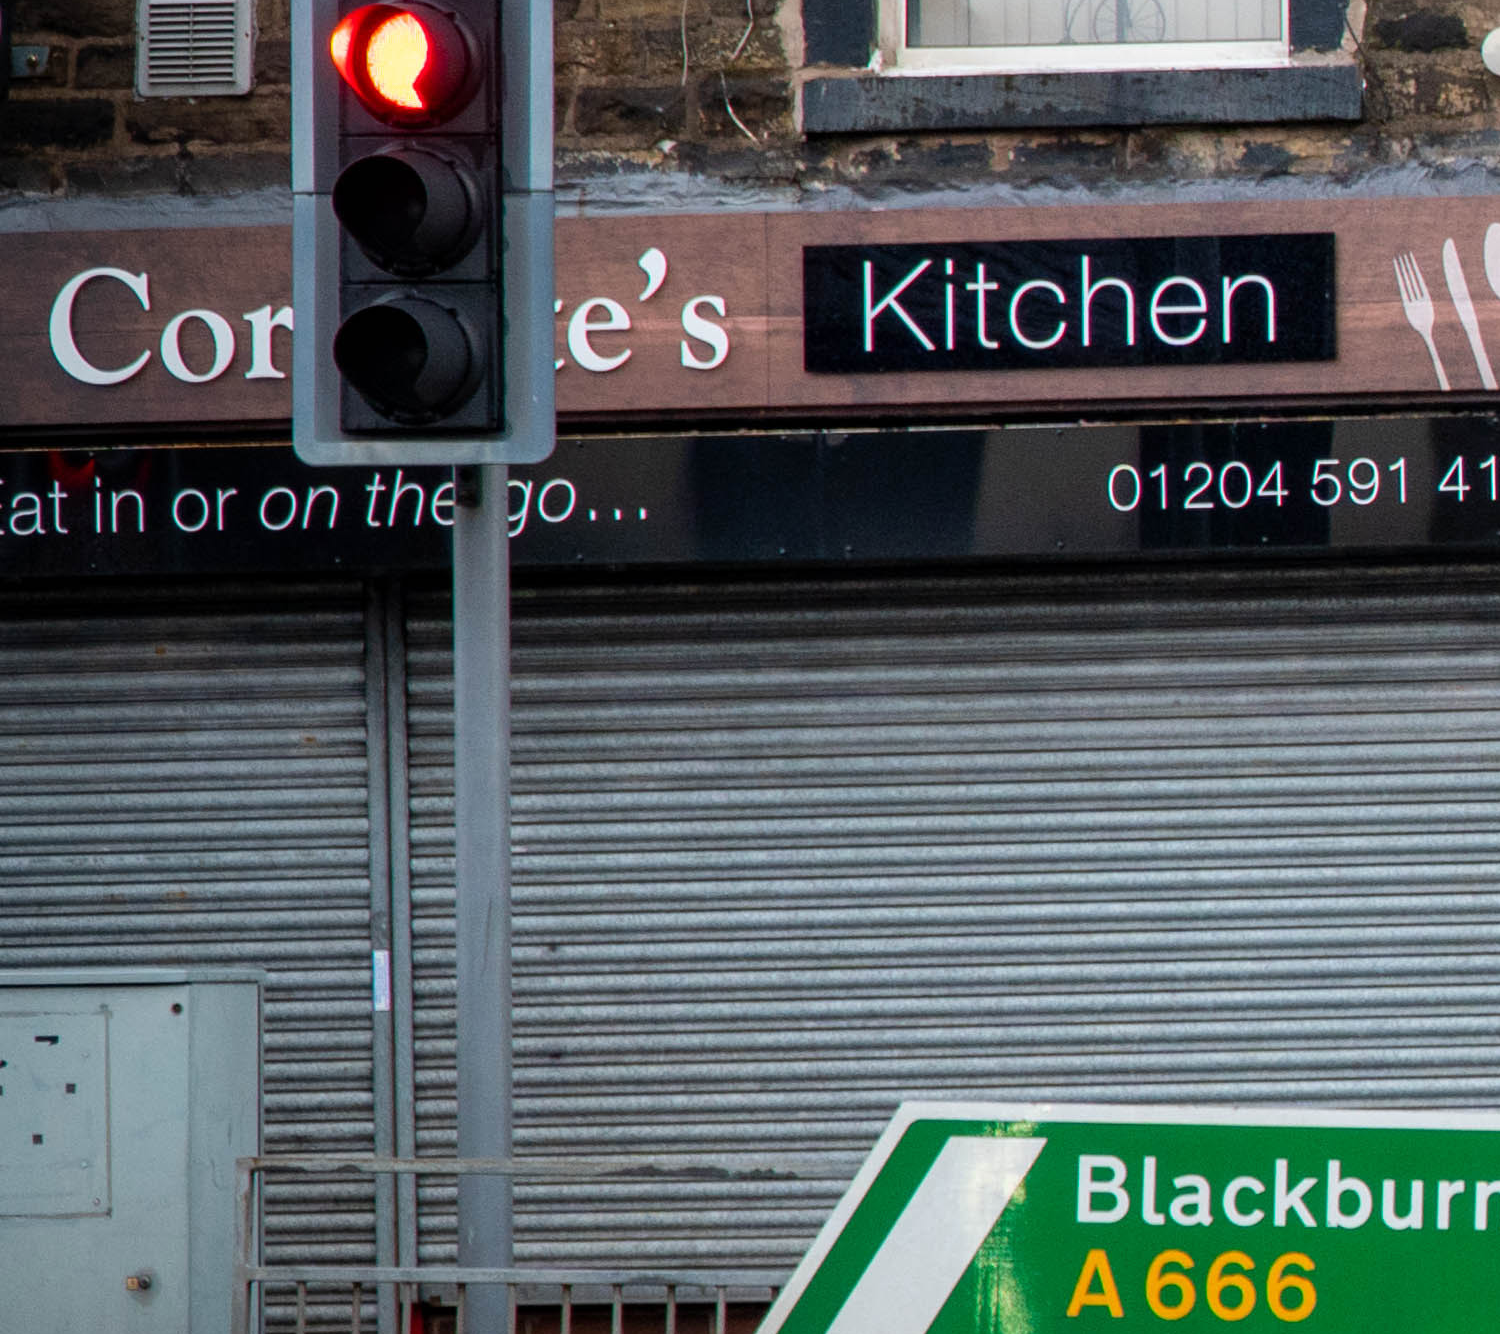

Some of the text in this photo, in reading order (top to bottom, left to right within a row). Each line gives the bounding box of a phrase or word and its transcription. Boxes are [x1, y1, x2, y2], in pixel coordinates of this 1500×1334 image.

[863, 255, 1277, 353] Kitchen
[0, 479, 69, 536] at
[95, 475, 145, 534] in
[172, 486, 238, 533] or
[259, 482, 339, 531] on
[366, 469, 456, 528] the
[1108, 460, 1289, 512] 01204
[1311, 456, 1411, 506] 591
[1066, 1249, 1319, 1322] A 666
